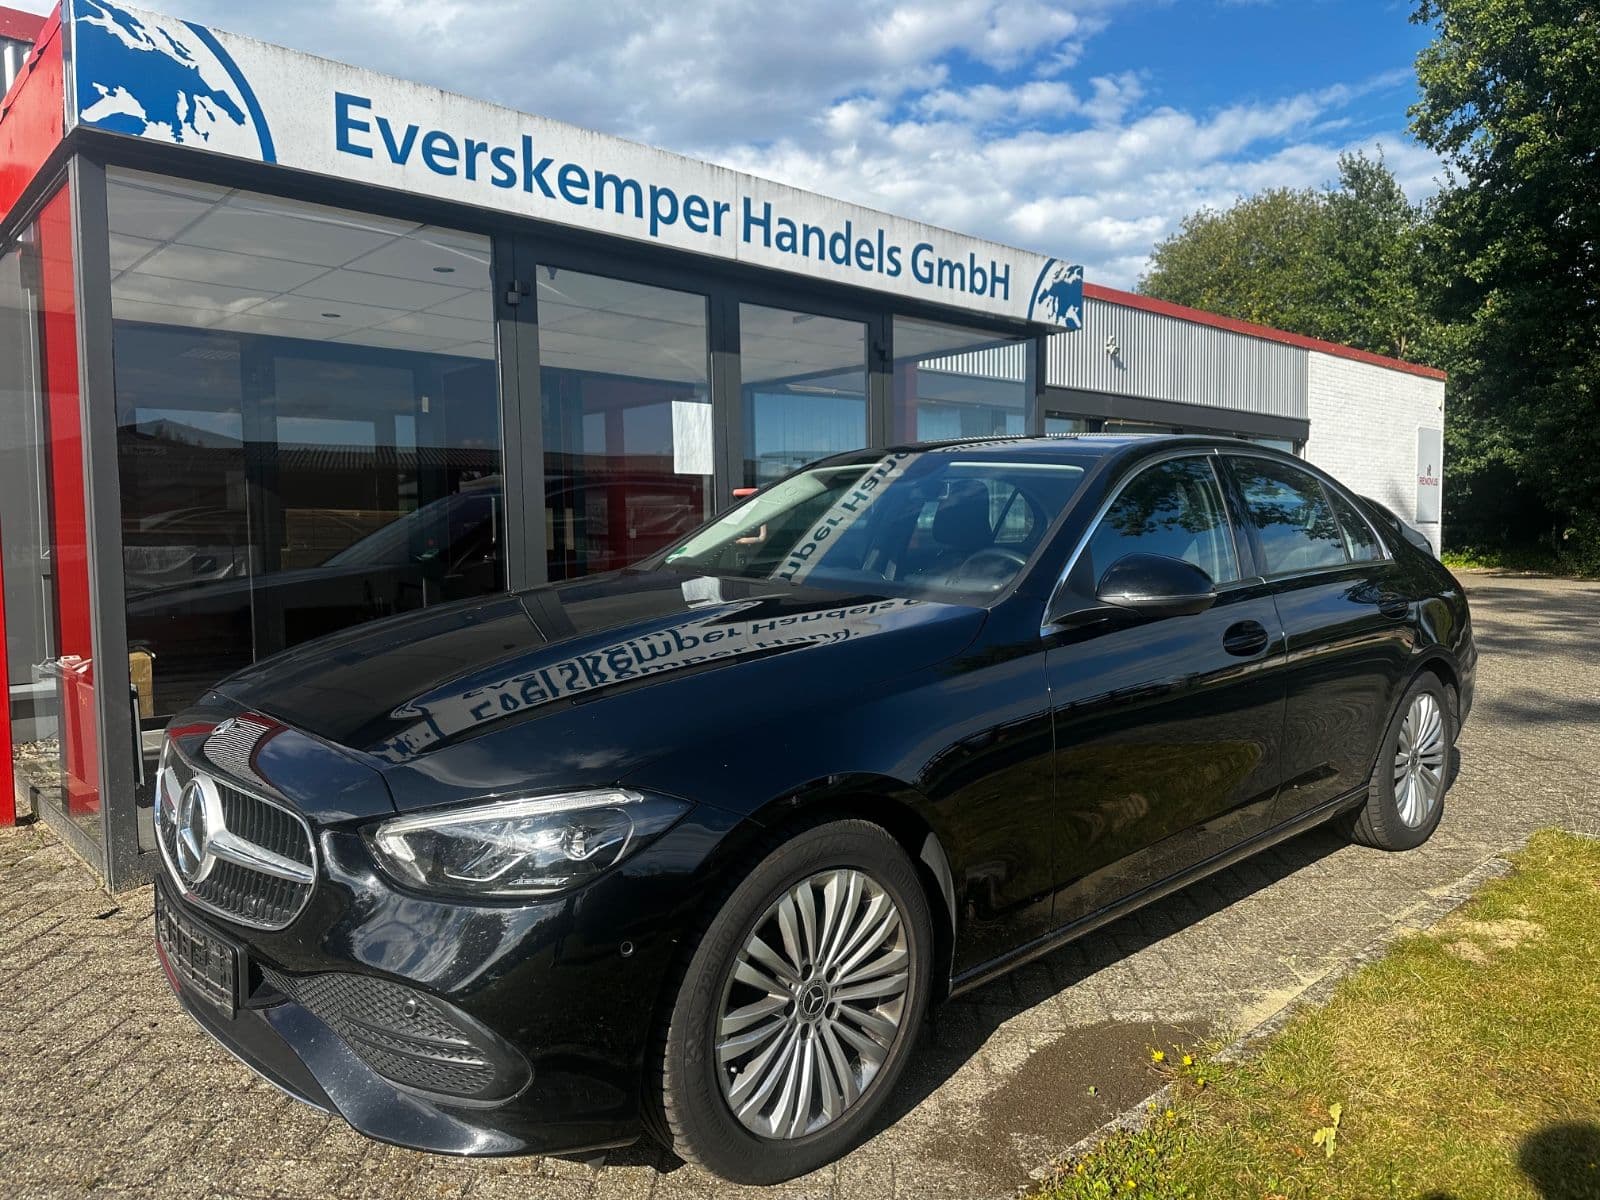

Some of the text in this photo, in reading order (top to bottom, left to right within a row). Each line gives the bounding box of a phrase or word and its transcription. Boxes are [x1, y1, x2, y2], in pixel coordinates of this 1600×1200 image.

[334, 91, 1010, 301] Everskemper Handels GmbH
